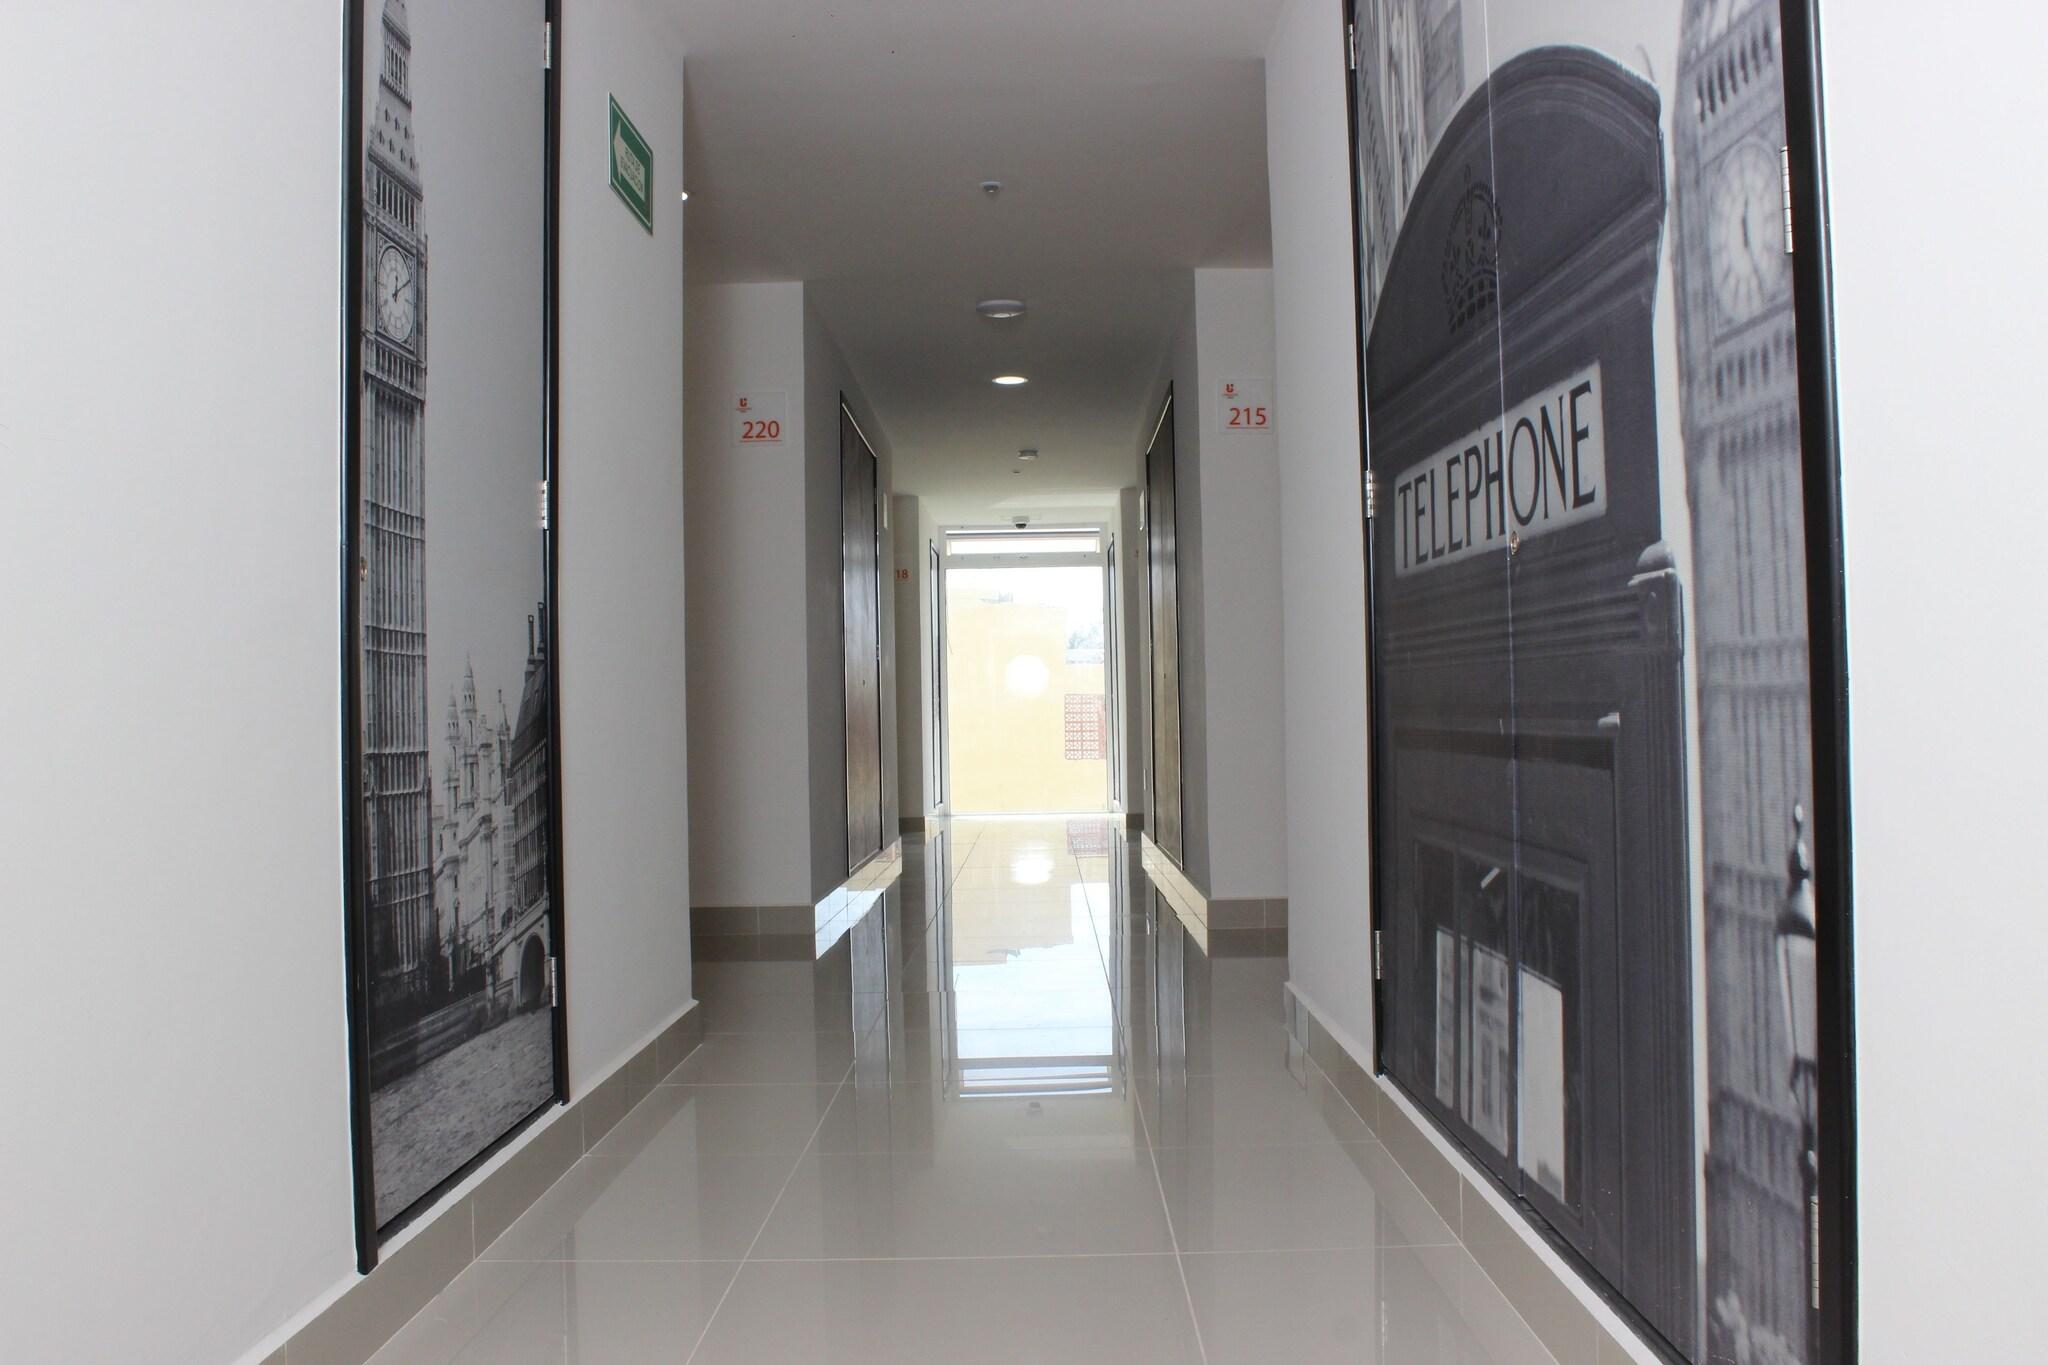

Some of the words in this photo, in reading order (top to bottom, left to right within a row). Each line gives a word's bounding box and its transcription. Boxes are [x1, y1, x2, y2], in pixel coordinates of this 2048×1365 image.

[1229, 407, 1266, 425] 215
[742, 420, 780, 439] 220
[1399, 380, 1596, 569] TELEPHONE
